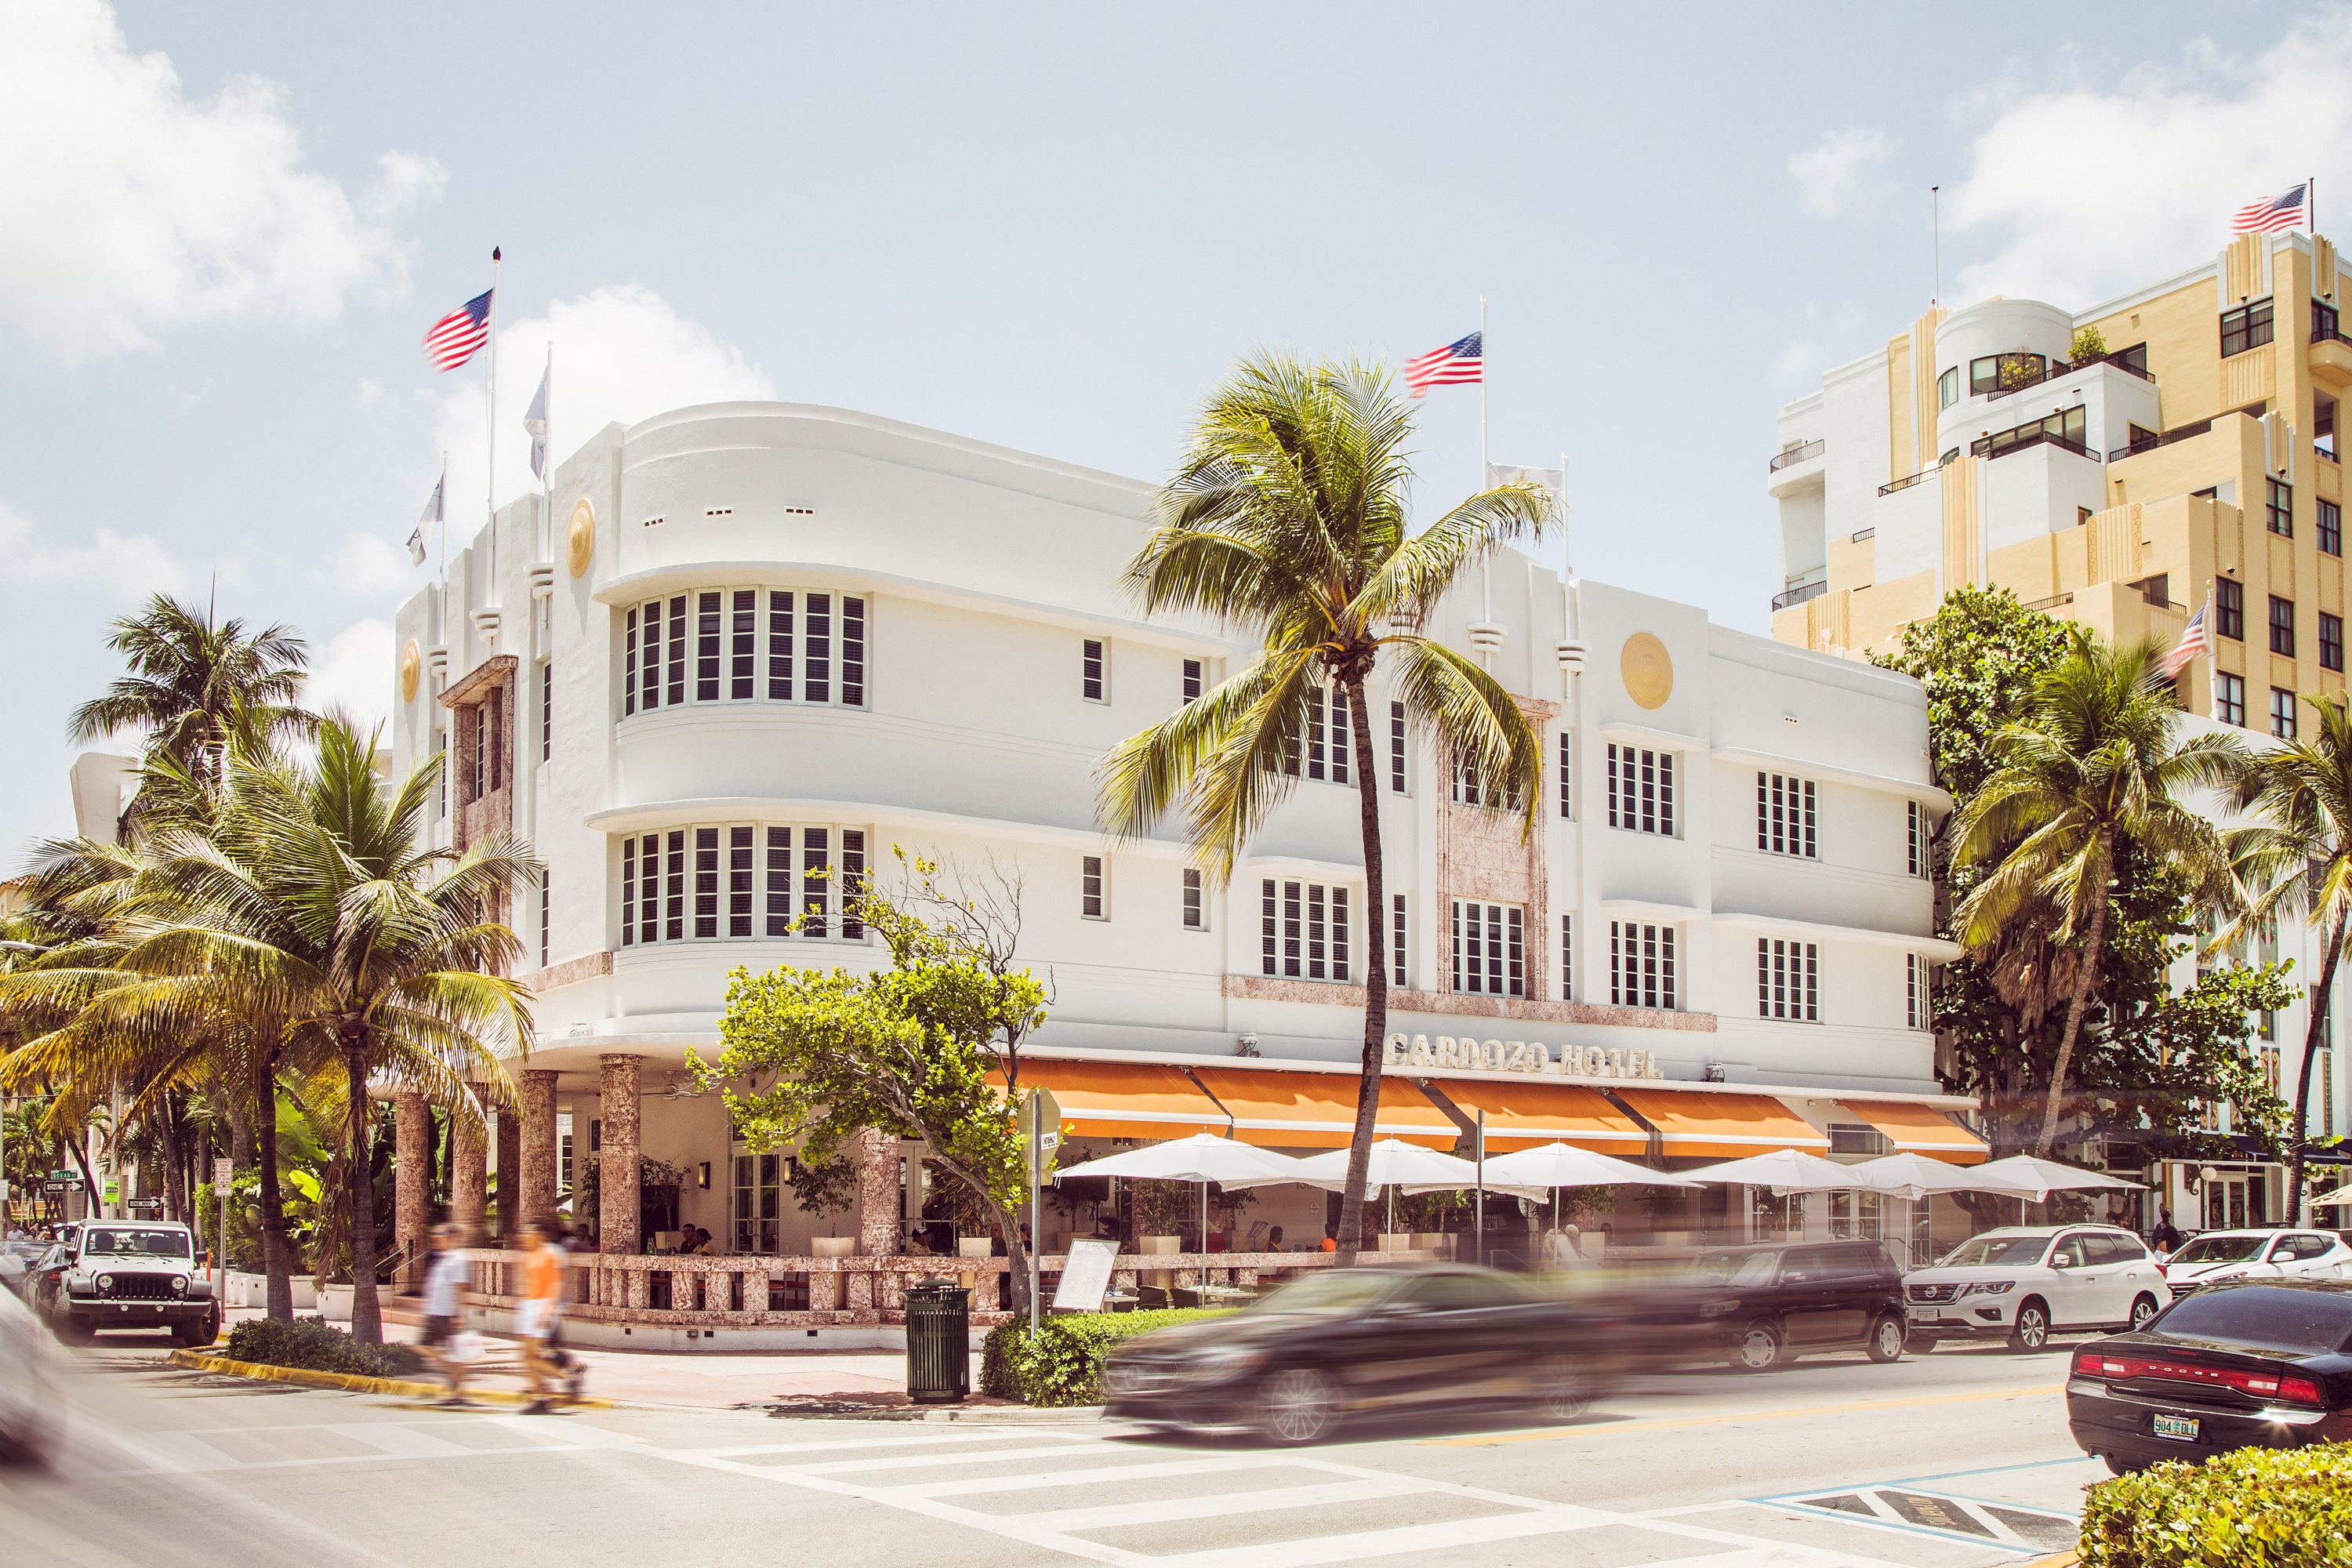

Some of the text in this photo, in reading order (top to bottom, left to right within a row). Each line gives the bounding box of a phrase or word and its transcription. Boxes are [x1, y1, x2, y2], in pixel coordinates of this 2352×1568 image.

[1384, 1033, 1664, 1080] CARDOZO HOTEL
[2149, 1366, 2219, 1377] DODGE
[2155, 1420, 2197, 1436] 904 DLL
